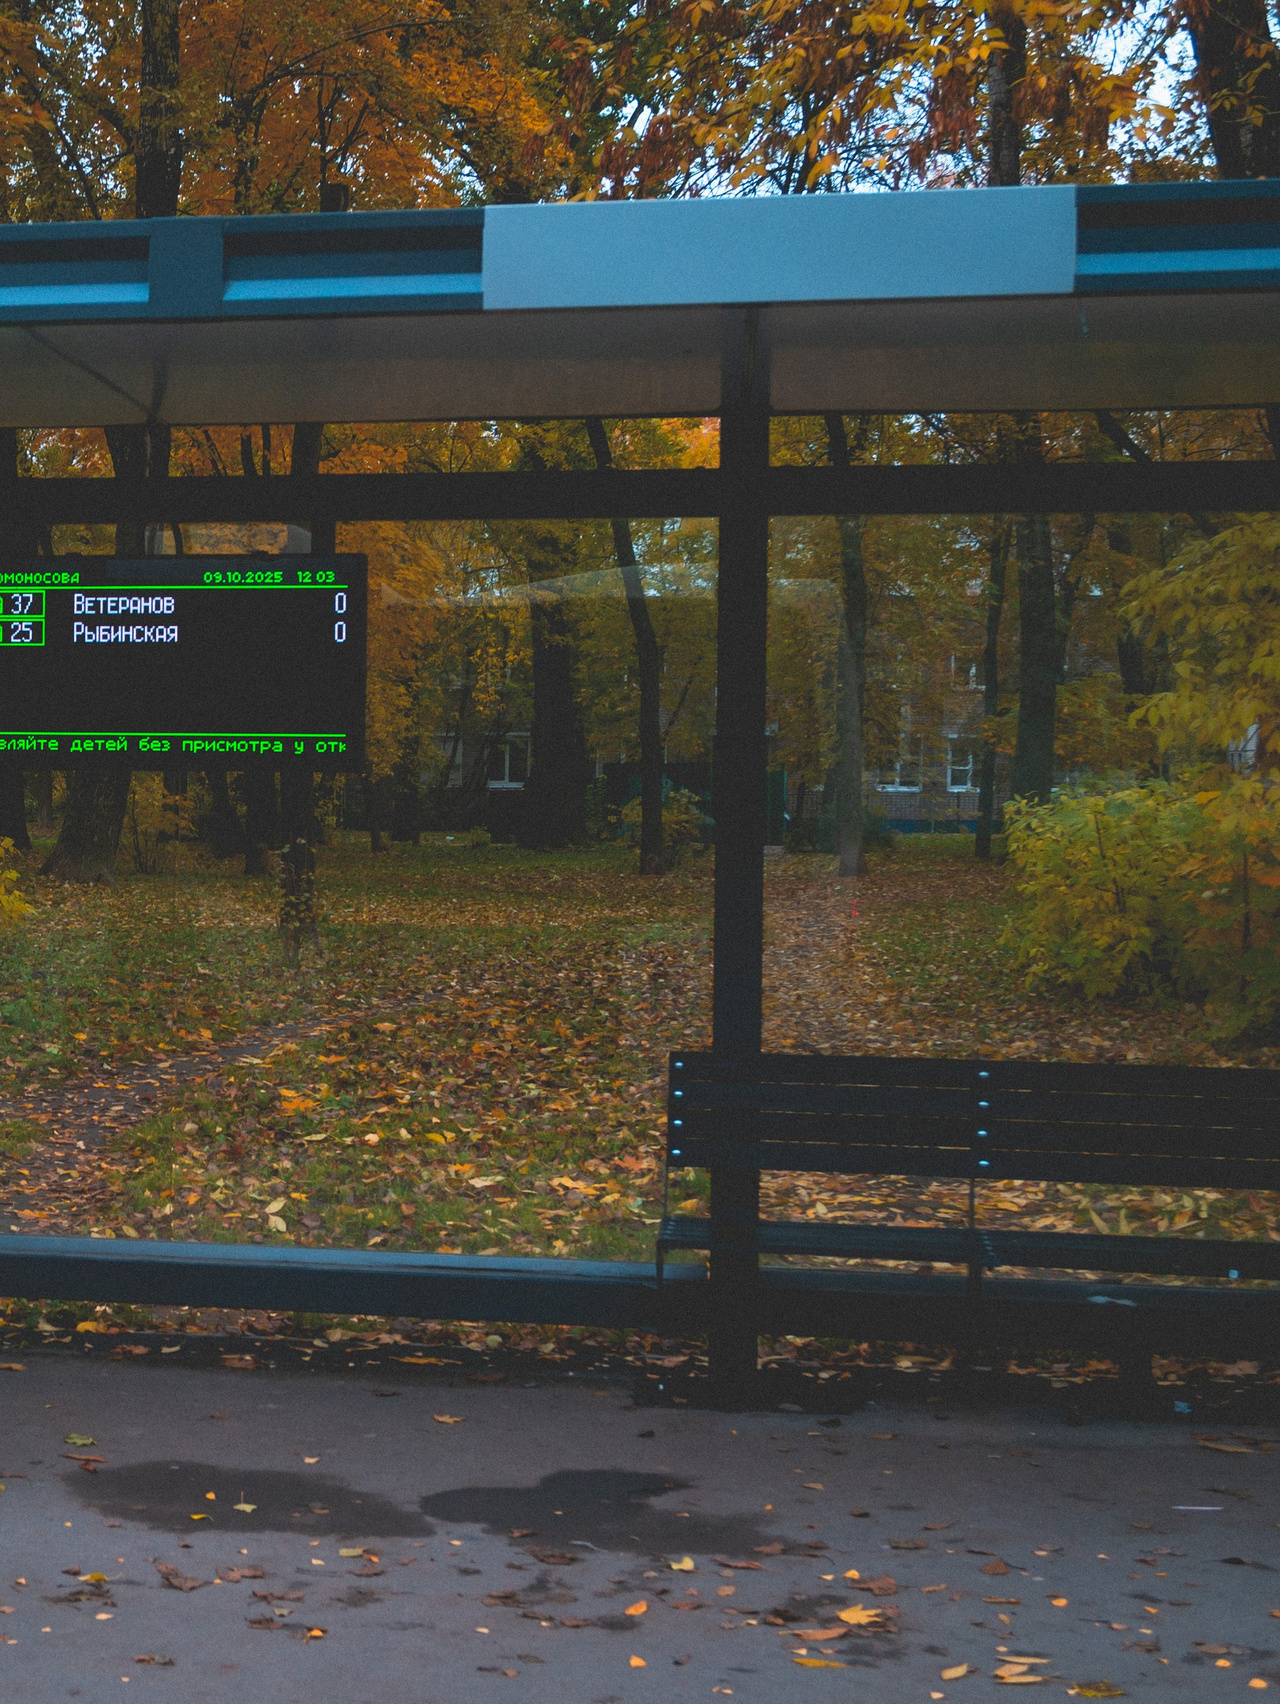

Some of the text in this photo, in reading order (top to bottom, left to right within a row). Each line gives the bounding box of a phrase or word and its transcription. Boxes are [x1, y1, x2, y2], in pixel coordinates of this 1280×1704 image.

[203, 571, 283, 583] 09.10.2025
[10, 593, 33, 614] 37
[334, 592, 347, 614] 0
[10, 622, 33, 643] 25
[334, 621, 347, 643] 0
[70, 737, 128, 753] детей
[138, 737, 171, 752] без
[182, 740, 283, 755] присмотра
[294, 741, 305, 755] у
